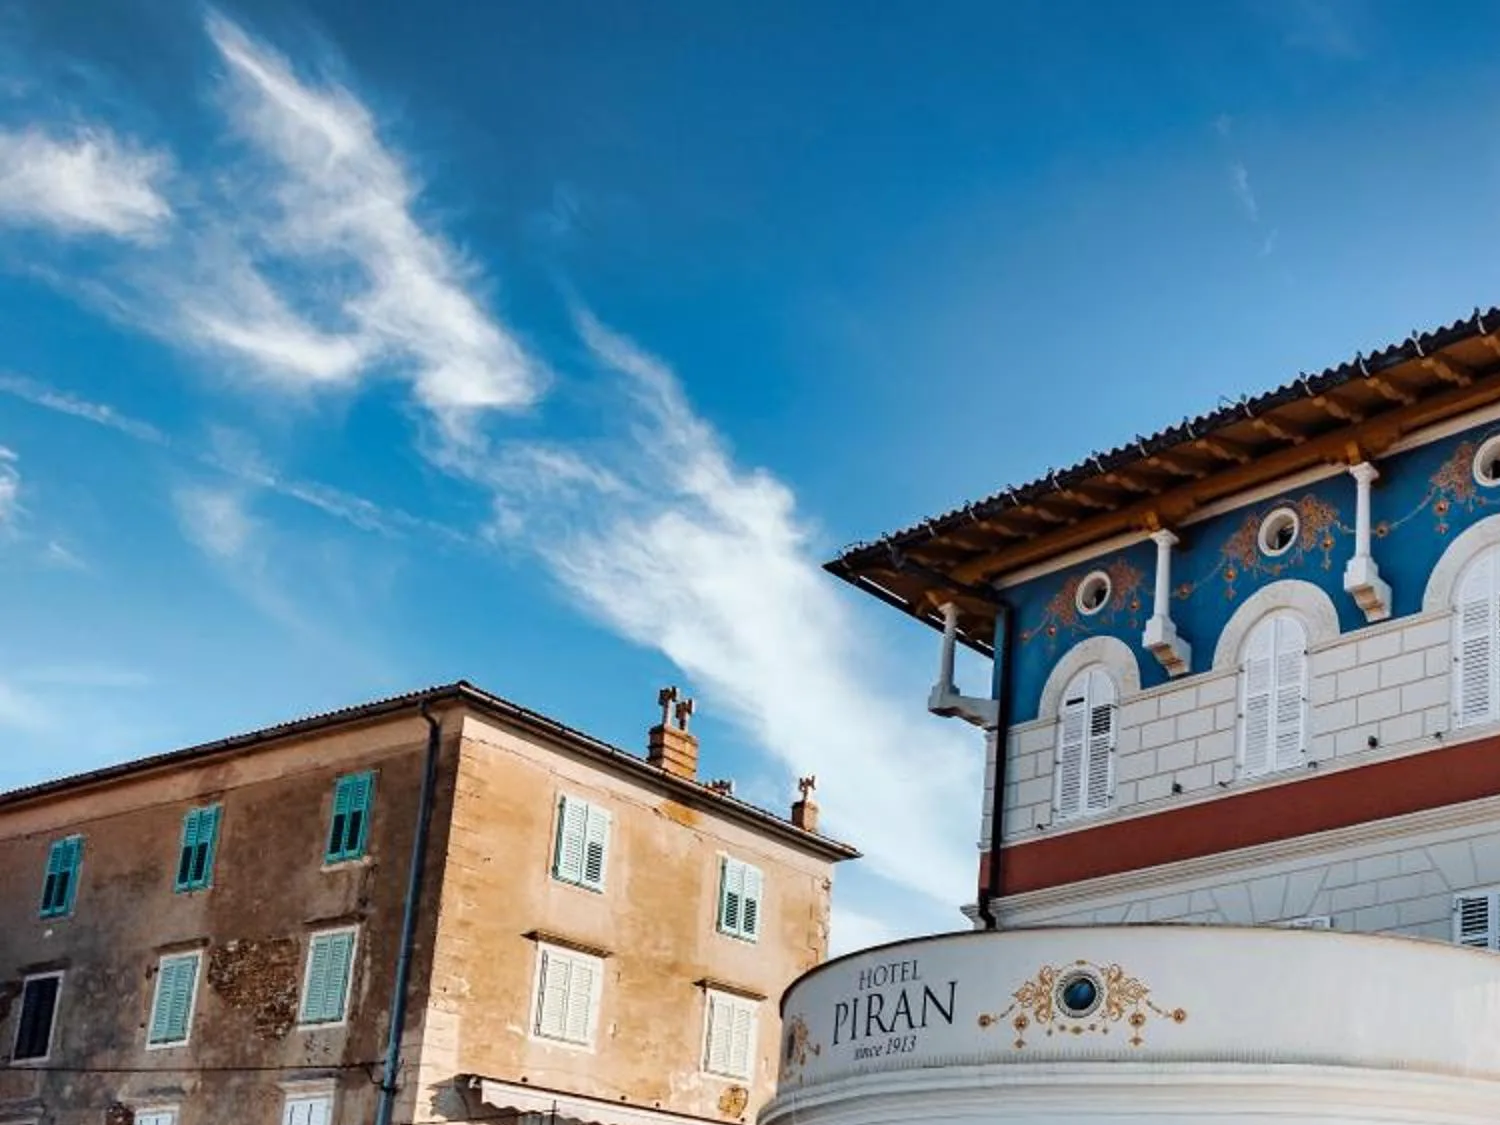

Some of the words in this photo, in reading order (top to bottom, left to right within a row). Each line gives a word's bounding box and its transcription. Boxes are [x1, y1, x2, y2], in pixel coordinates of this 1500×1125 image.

[858, 960, 920, 990] HOTEL
[832, 981, 957, 1046] PIRAN
[854, 1044, 882, 1060] since
[886, 1035, 917, 1055] 1913
